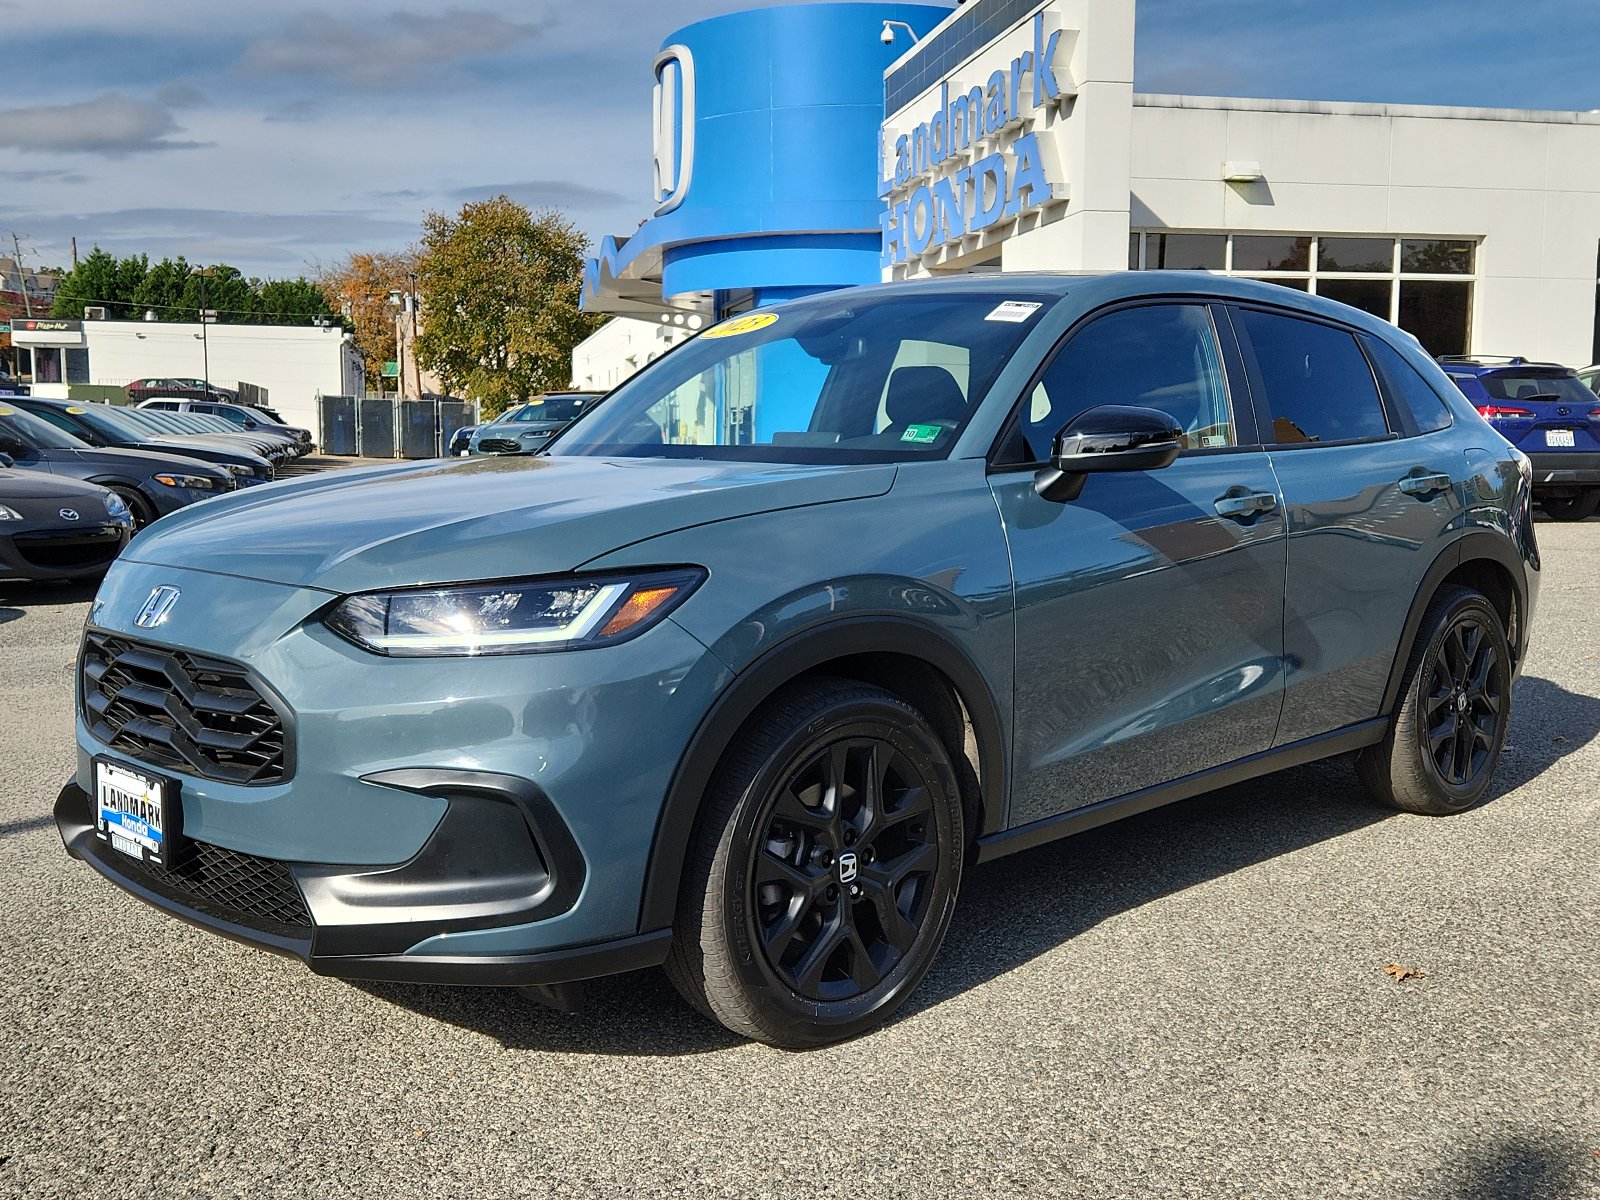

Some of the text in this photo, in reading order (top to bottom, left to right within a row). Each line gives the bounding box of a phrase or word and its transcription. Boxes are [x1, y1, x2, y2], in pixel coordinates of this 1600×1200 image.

[877, 11, 1063, 199] Landmark
[879, 131, 1052, 269] HONDA
[905, 430, 916, 438] 10
[102, 784, 161, 831] LANDMARK
[121, 813, 149, 836] Honda
